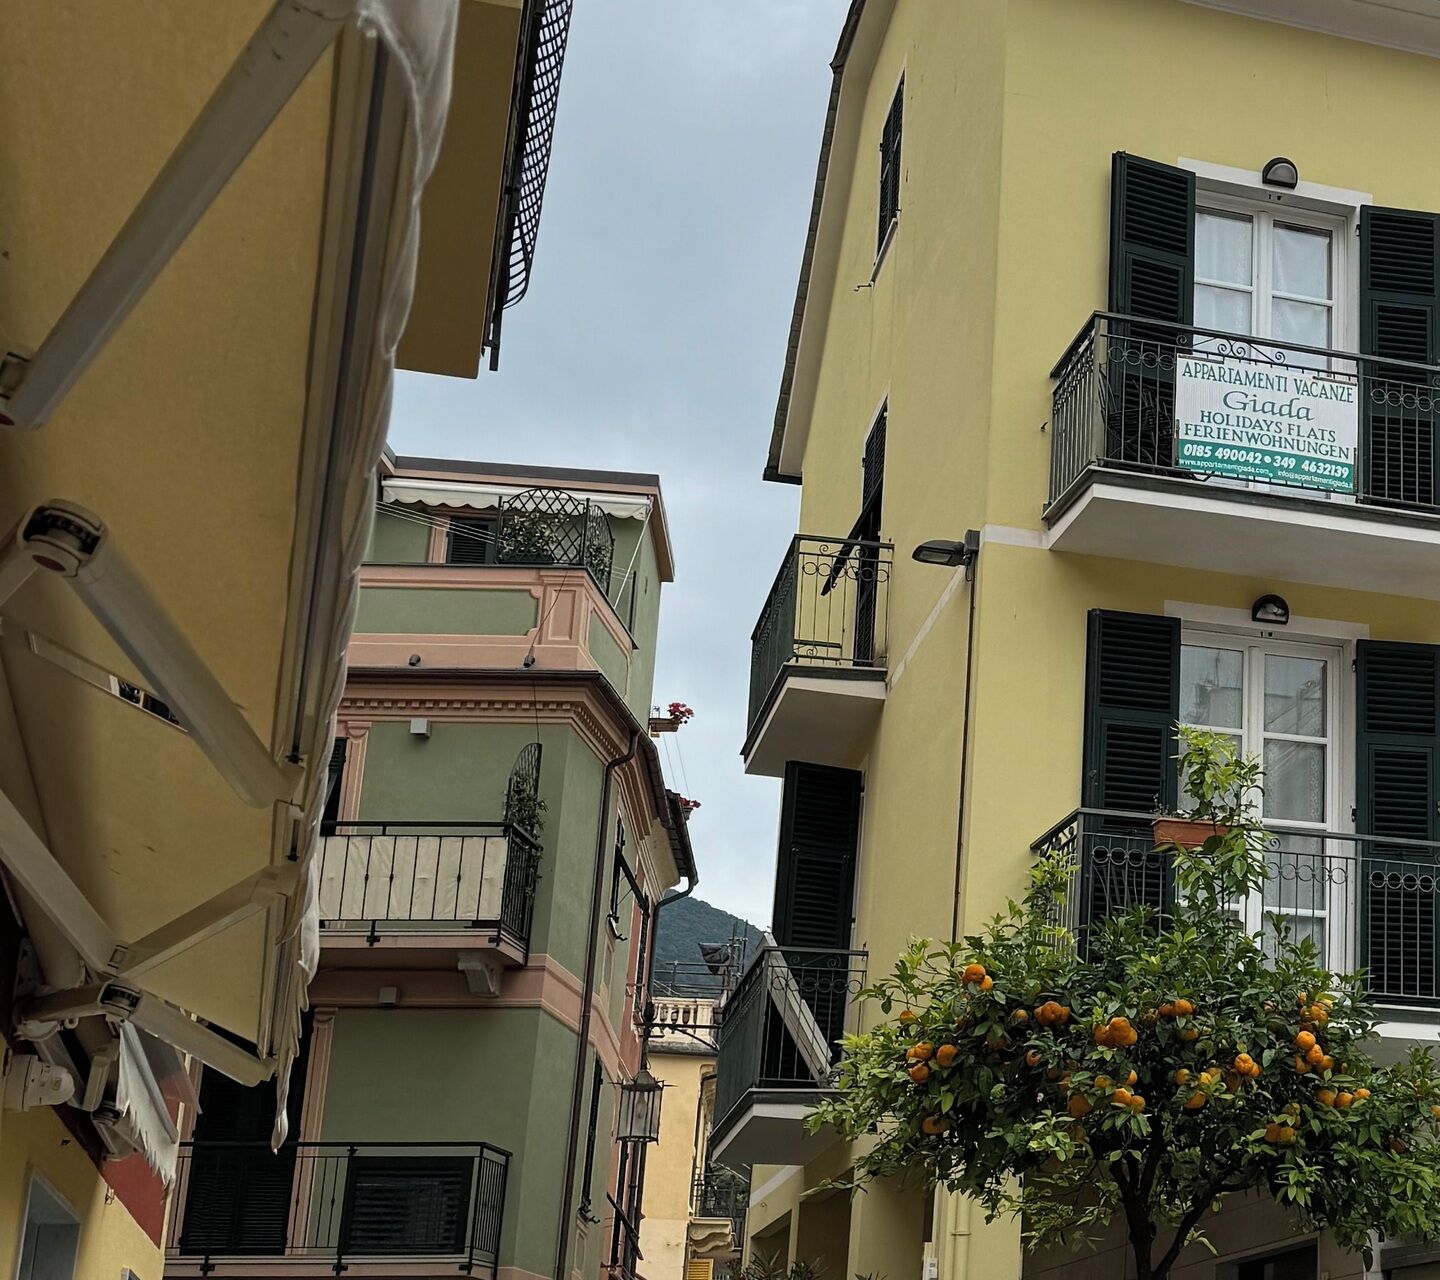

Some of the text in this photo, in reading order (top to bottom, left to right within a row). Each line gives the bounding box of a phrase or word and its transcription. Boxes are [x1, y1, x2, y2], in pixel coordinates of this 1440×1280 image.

[1182, 361, 1354, 404] APPARTAMENTI VACANZE
[1222, 390, 1314, 421] Giada
[1184, 423, 1350, 460] FERIENWOHNUNGEN
[1200, 410, 1336, 442] HOLIDAYS FLATS
[1183, 443, 1350, 479] 0185 490042 349 4632139
